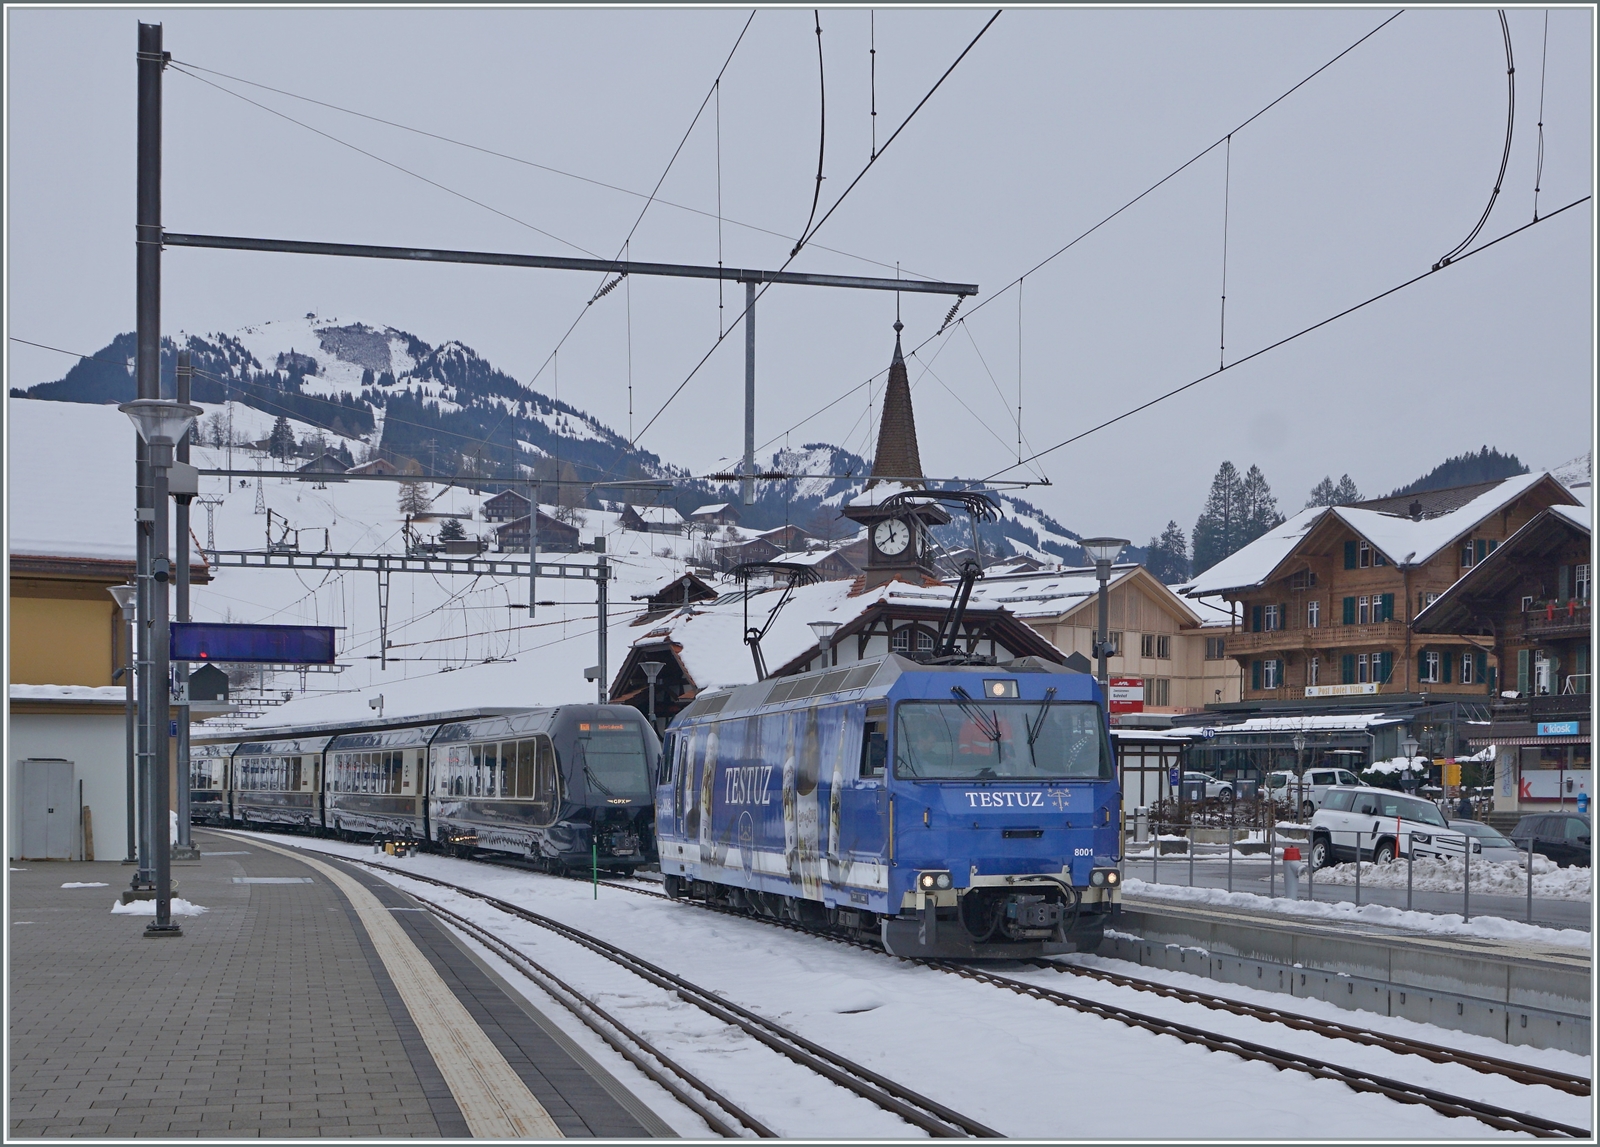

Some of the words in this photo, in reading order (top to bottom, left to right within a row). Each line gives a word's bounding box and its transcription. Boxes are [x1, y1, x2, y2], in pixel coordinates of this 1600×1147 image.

[1317, 687, 1330, 695] Post
[1332, 686, 1347, 695] Hotel
[1350, 685, 1363, 694] Vista
[1549, 724, 1571, 733] kiosk
[725, 765, 773, 805] TESTUZ
[965, 792, 1044, 807] TESTUZ
[1074, 848, 1094, 857] 8001
